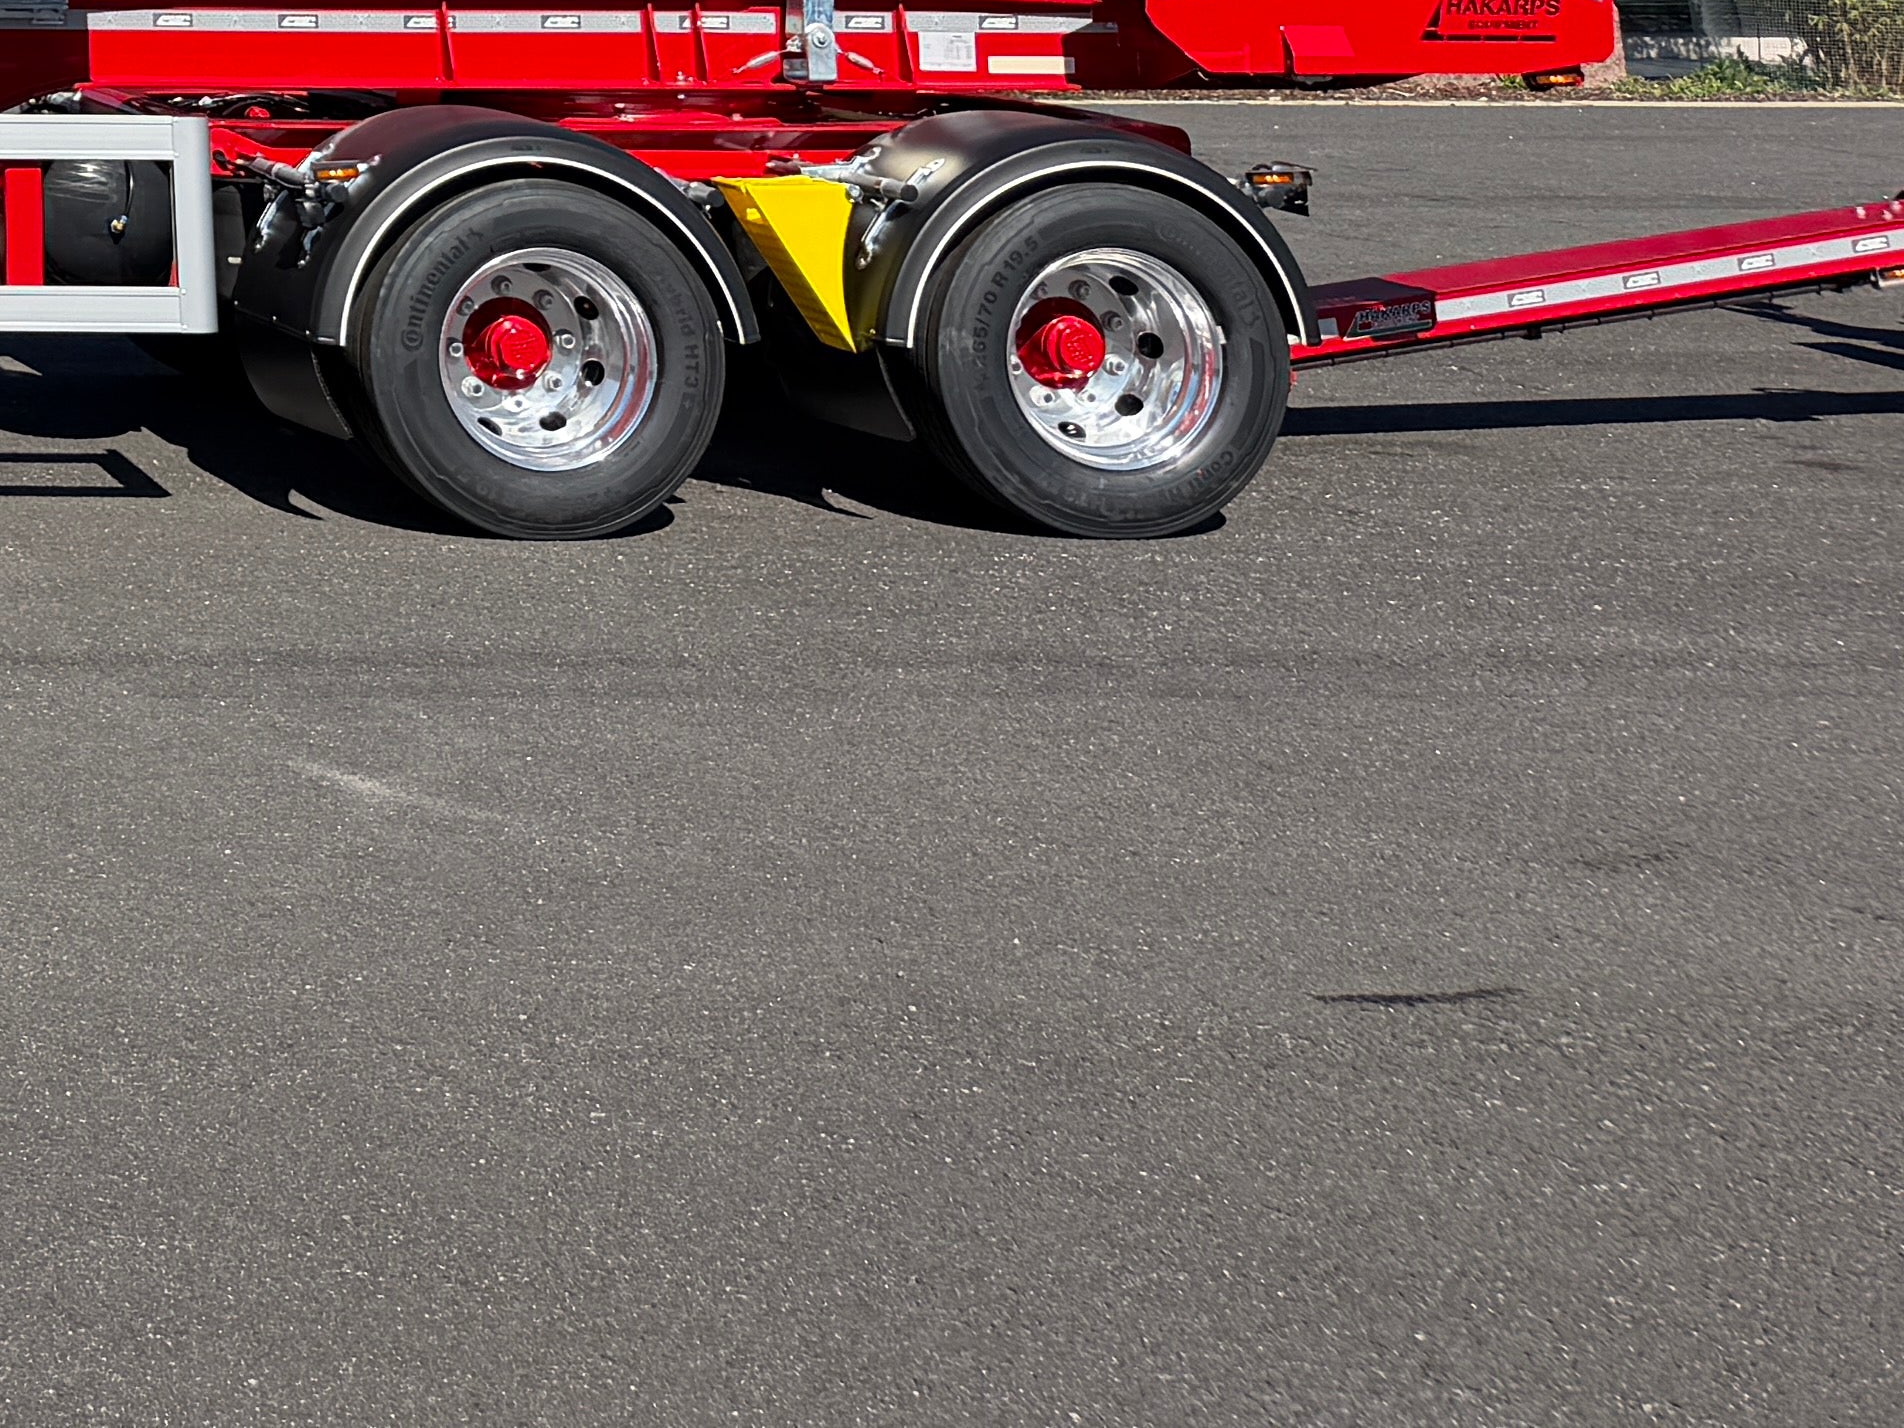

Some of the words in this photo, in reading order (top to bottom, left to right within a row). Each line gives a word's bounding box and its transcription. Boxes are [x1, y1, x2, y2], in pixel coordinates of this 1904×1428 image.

[993, 273, 1007, 288] R
[1003, 238, 1039, 271] 19.5
[401, 236, 470, 350] Continental
[1359, 300, 1431, 321] HAKARPS
[683, 344, 699, 389] HT3
